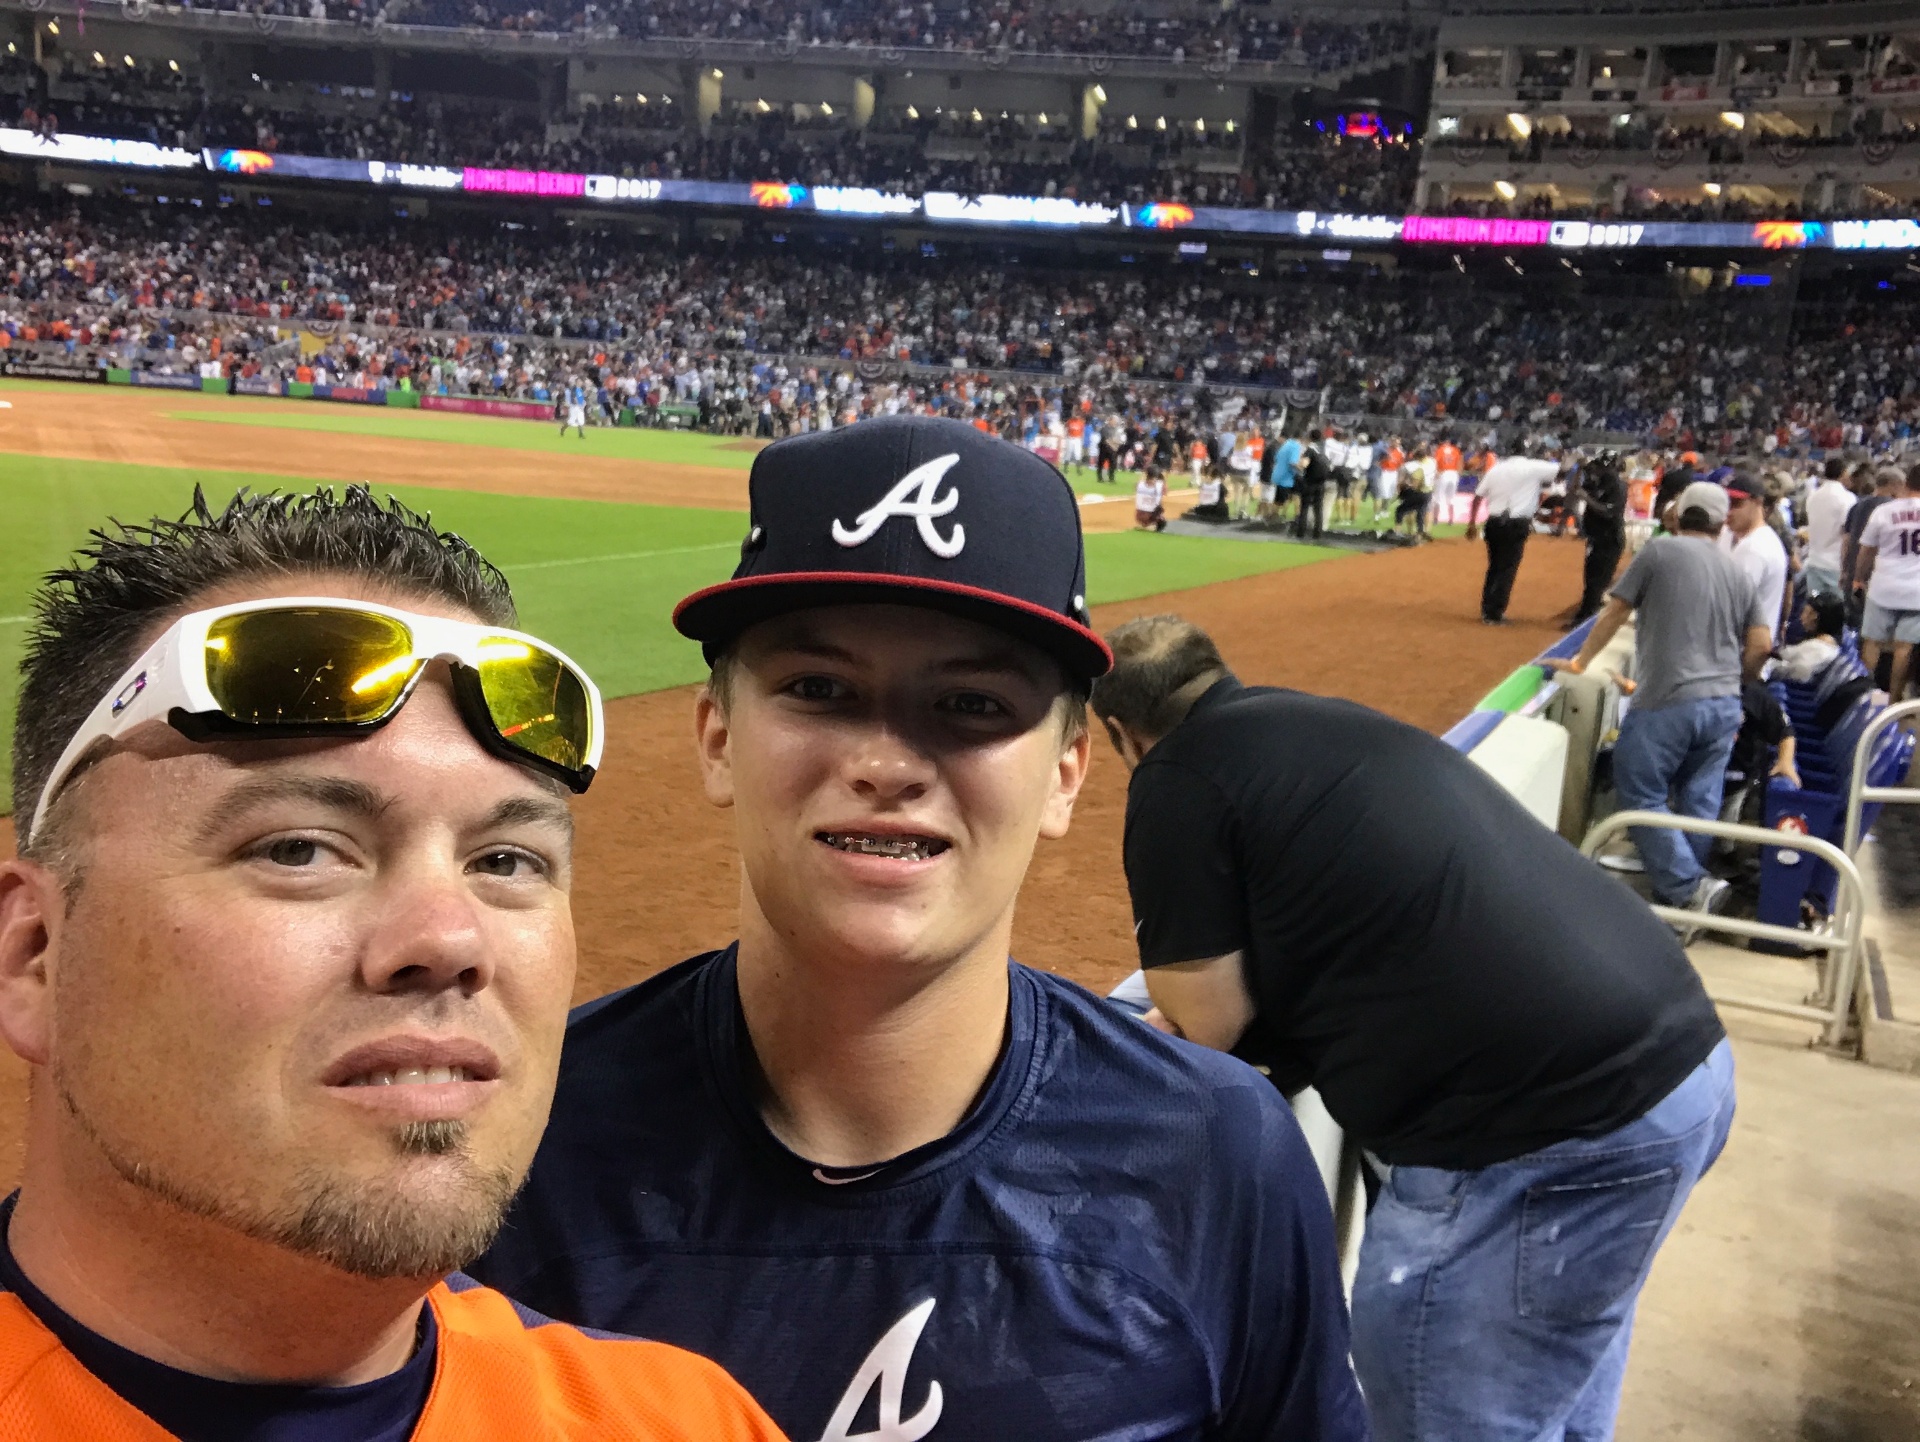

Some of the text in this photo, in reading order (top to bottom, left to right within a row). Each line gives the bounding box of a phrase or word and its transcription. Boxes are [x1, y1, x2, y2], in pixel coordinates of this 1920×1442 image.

[1404, 216, 1452, 241] HOME
[1454, 217, 1491, 242] RUN
[1492, 218, 1550, 245] DERBY
[832, 453, 965, 559] A
